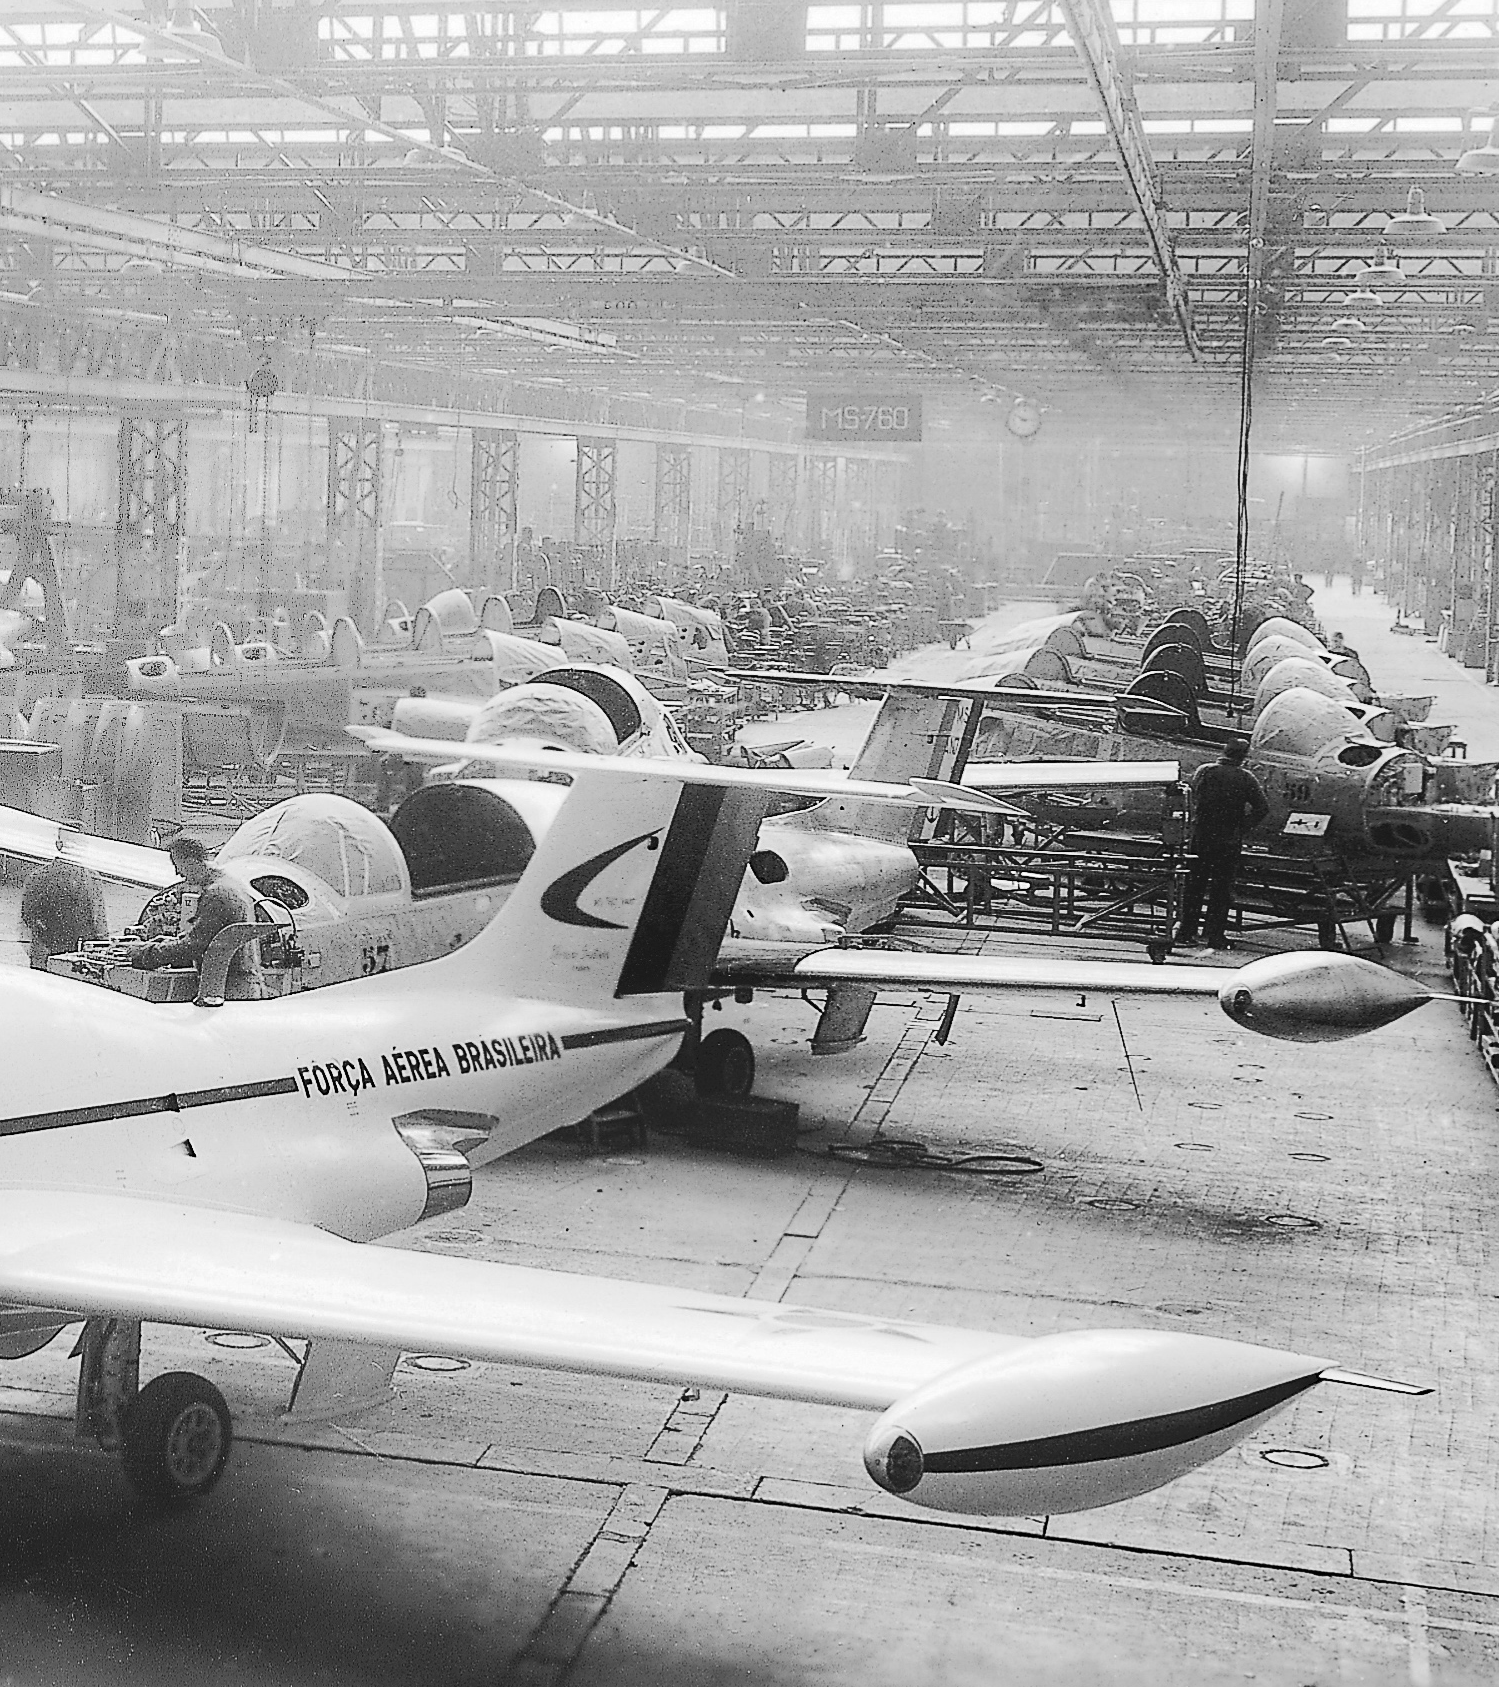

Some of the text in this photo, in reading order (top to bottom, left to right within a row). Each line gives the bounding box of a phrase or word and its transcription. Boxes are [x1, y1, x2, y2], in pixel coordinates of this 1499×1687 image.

[820, 405, 909, 430] MS-760
[362, 944, 390, 975] 57
[298, 1031, 562, 1098] FORÇA AÉREA BRASILEIRA
